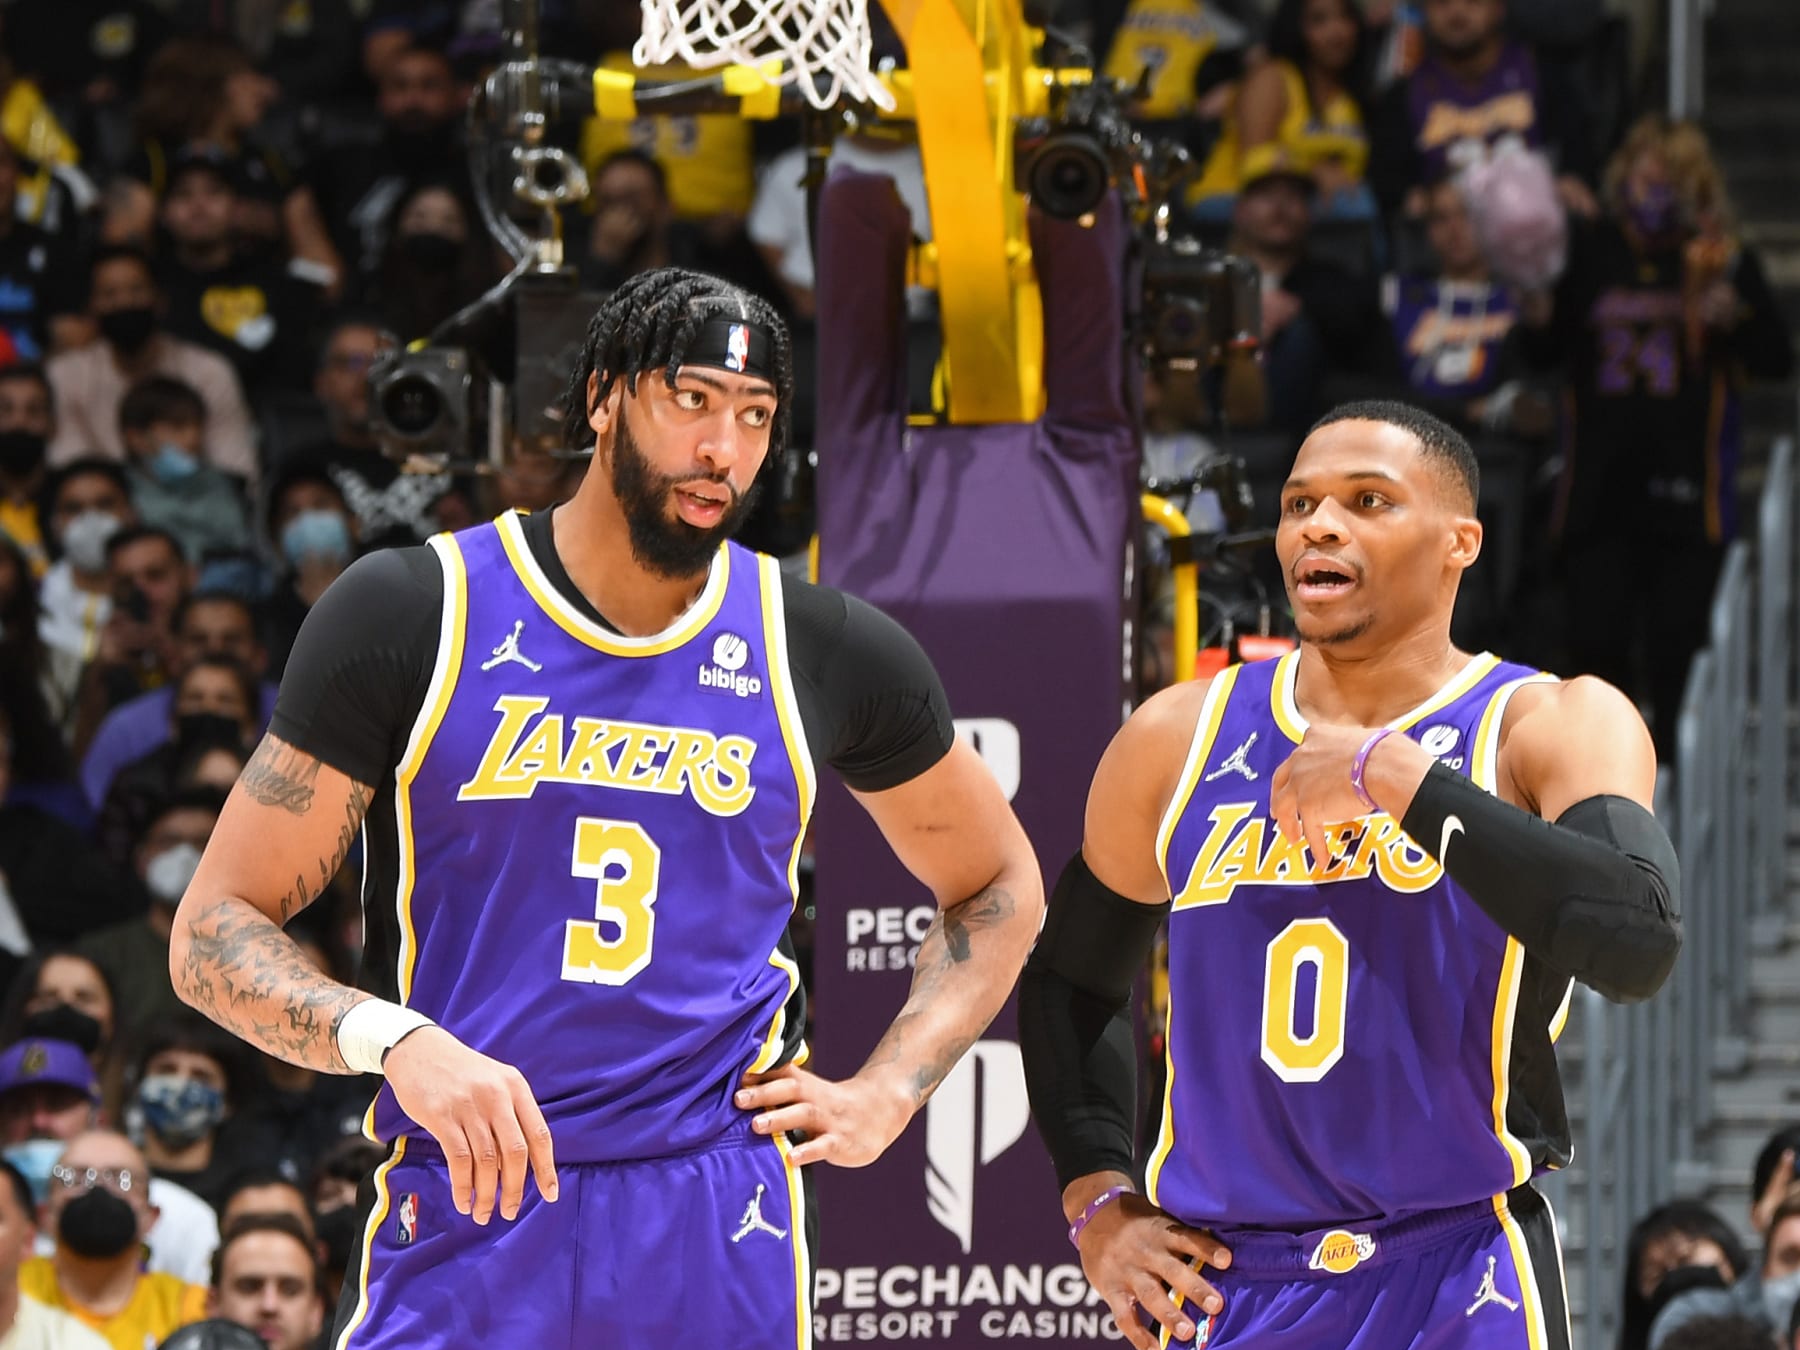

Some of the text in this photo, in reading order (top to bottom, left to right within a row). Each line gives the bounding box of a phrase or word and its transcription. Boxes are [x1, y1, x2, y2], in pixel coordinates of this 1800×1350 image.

[699, 664, 762, 697] bibigo
[456, 695, 757, 817] LAKERS
[560, 816, 661, 986] 3
[1260, 917, 1349, 1083] 0
